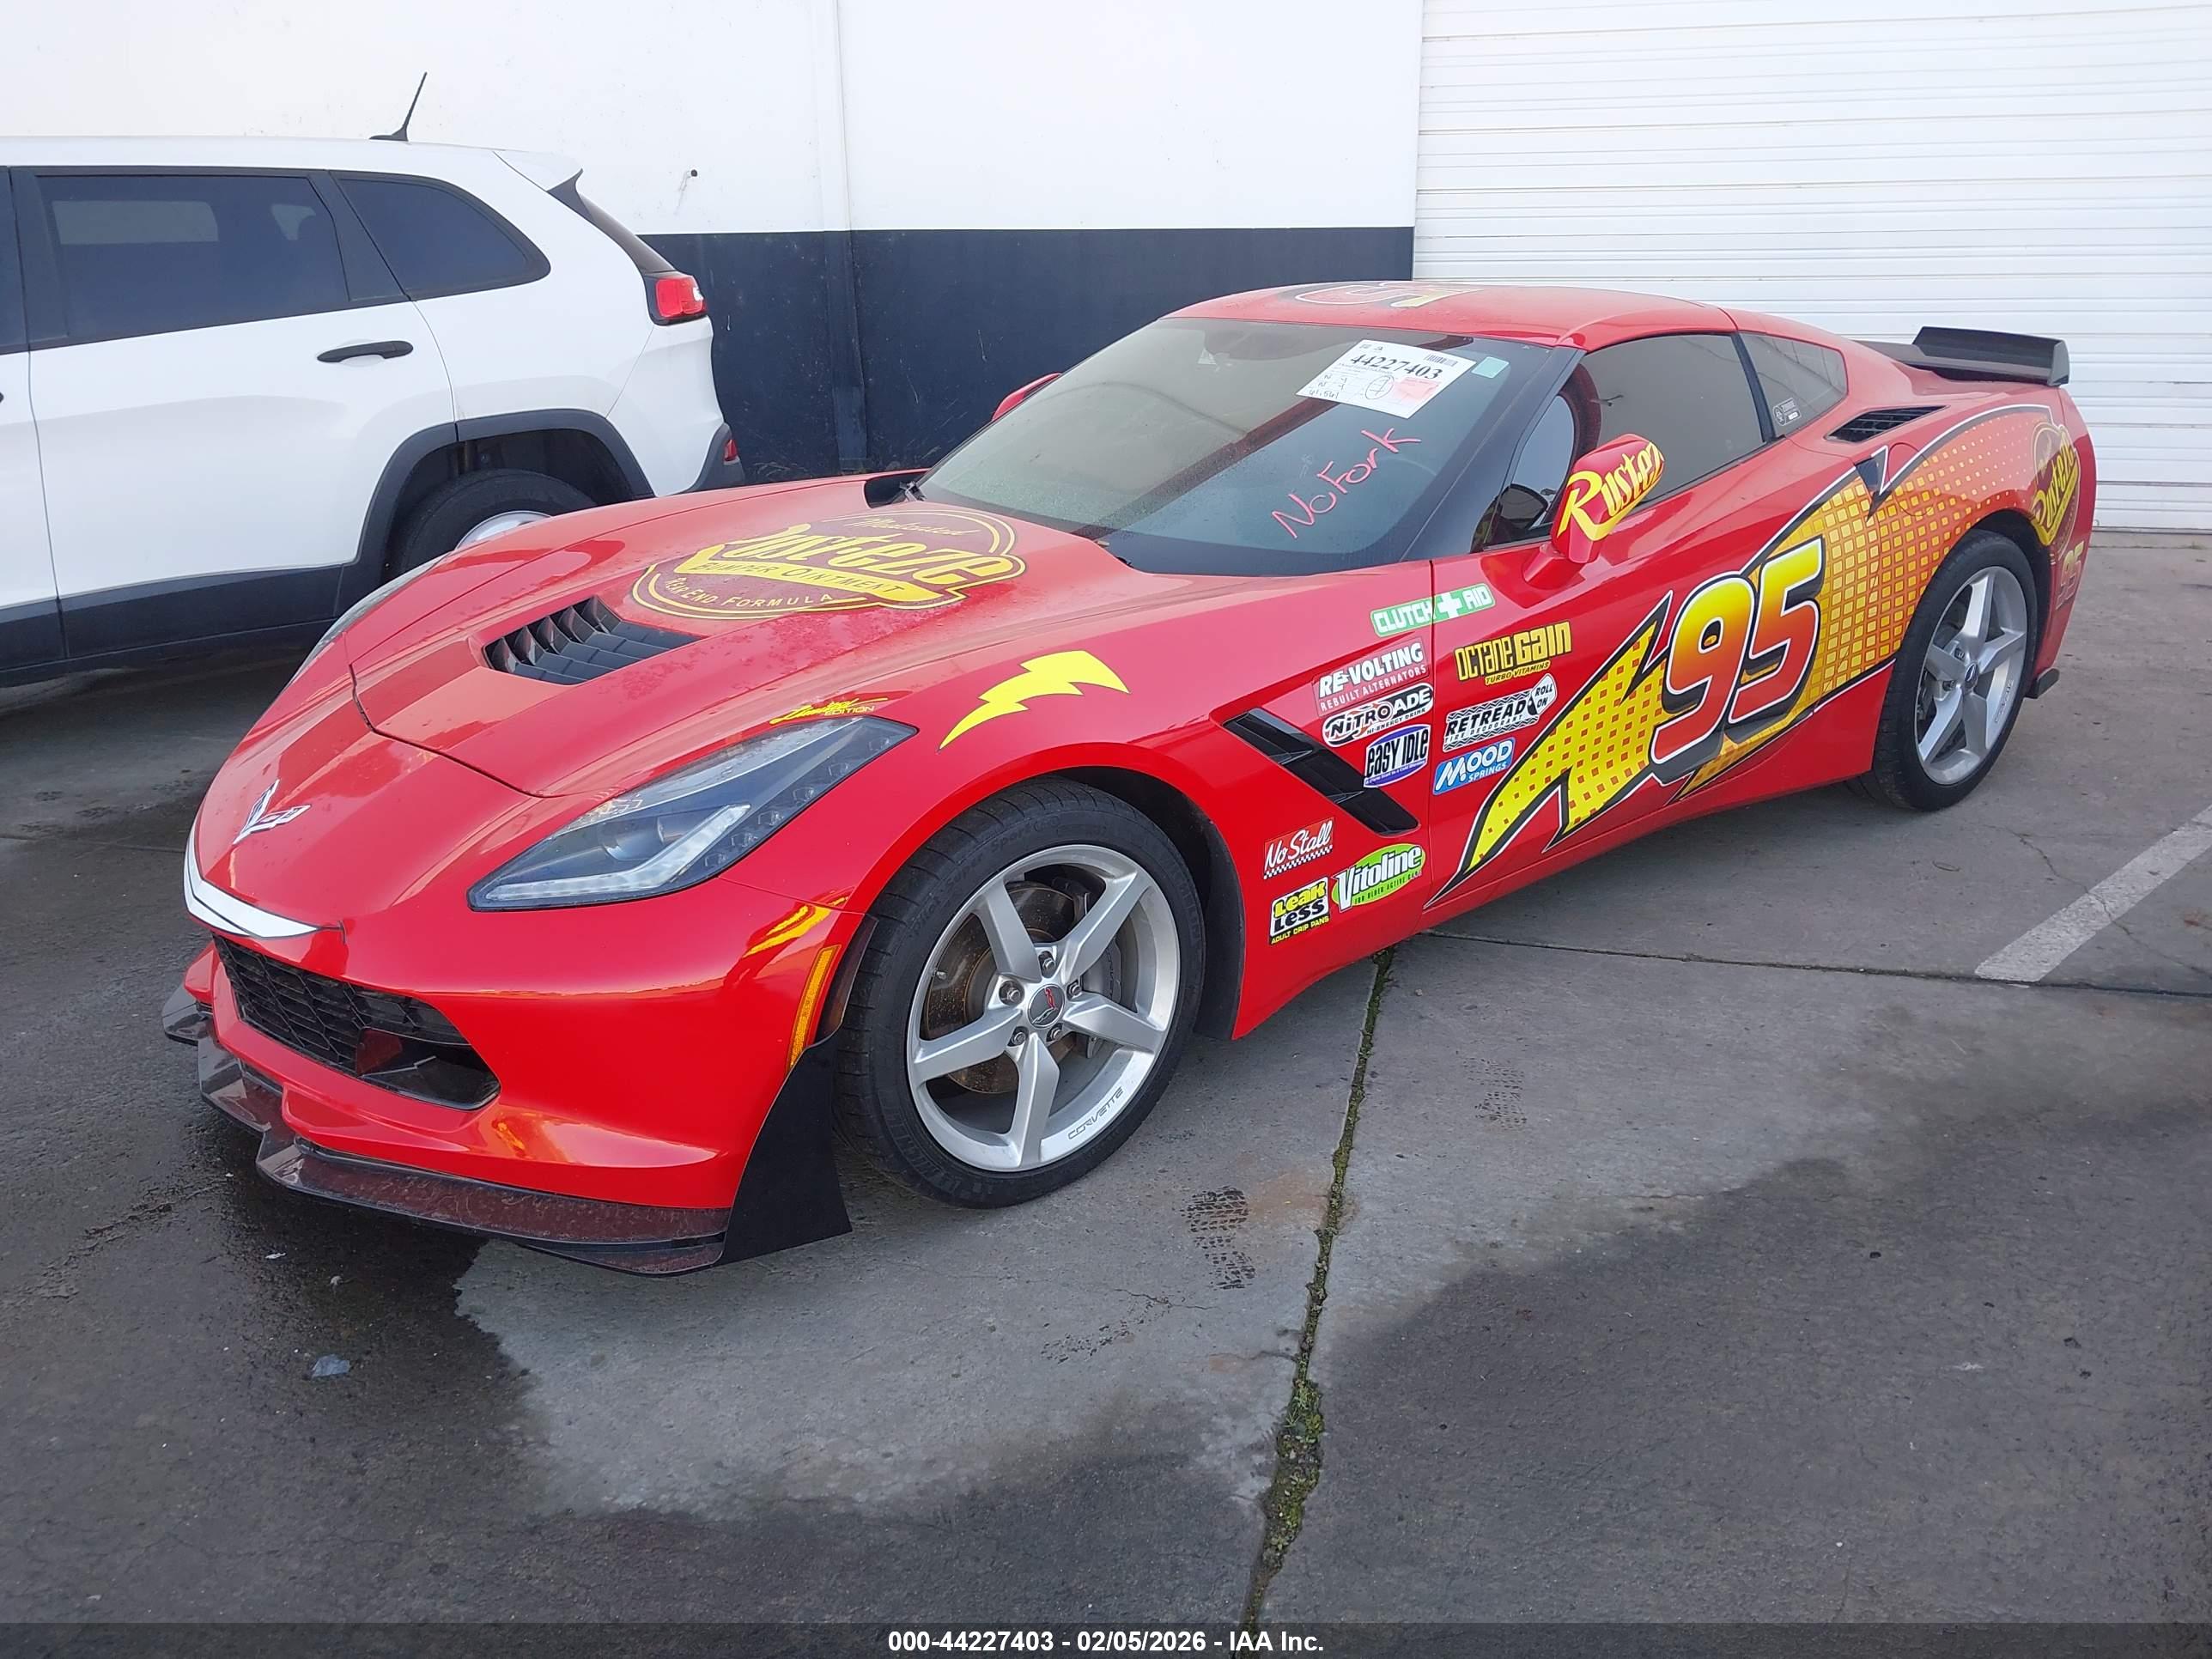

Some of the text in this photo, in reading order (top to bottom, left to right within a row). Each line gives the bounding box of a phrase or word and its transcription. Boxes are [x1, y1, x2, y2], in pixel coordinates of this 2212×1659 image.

[1351, 354, 1443, 380] 44227403
[690, 562, 905, 592] BUMPER OINTMENT
[685, 589, 718, 604] END
[721, 593, 833, 607] FORMULA
[1374, 586, 1492, 633] CLUTCH AID
[1650, 537, 1825, 767] 95
[1486, 660, 1550, 684] TURBO VITAMINS
[1321, 665, 1426, 712] REBUILT ALTERNATORS
[1535, 684, 1553, 697] ROLL
[1536, 697, 1548, 708] ON
[824, 706, 875, 716] EDITION
[1404, 708, 1425, 720] DRINK
[1446, 700, 1527, 737] RETREAD
[1471, 715, 1522, 735] DEODORANT
[1436, 739, 1513, 791] MOOD
[1468, 762, 1507, 782] SPRINGS
[1265, 820, 1333, 869] No Stall
[1334, 846, 1422, 912] Vitoline
[1271, 915, 1329, 945] ADULT DRIP PANS
[1068, 1087, 1124, 1140] CORVETTE
